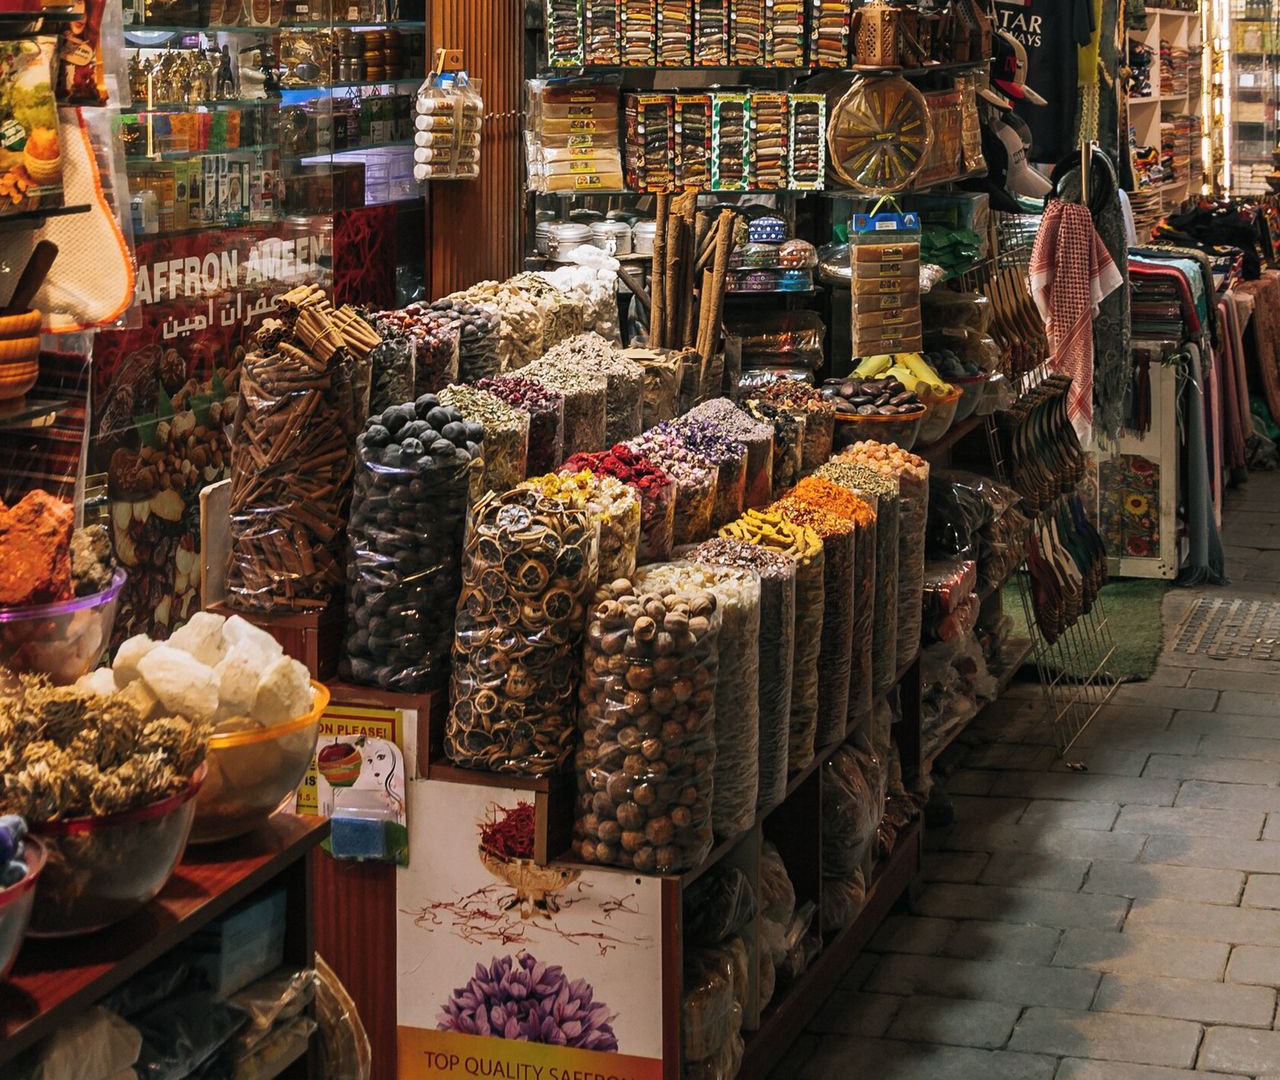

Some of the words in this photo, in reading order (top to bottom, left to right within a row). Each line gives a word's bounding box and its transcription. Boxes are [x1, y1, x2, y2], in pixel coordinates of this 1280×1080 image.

[1000, 10, 1042, 34] TAR
[136, 250, 238, 306] AFFRON
[337, 724, 387, 738] PLEASE!
[424, 1051, 460, 1071] TOP
[465, 1056, 544, 1080] QUALITY
[550, 1067, 637, 1080] SAFF
